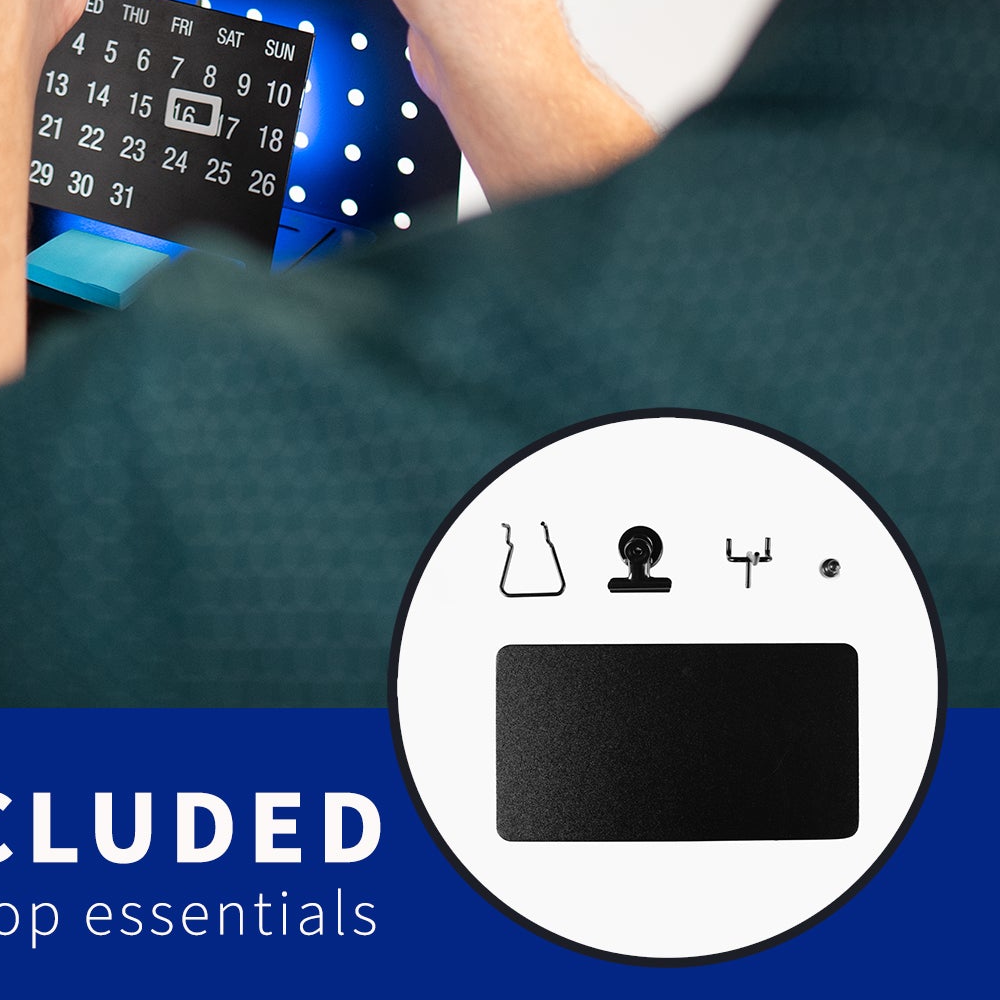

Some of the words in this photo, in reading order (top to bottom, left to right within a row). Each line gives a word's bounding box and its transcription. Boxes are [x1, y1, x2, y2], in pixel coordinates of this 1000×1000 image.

[72, 32, 86, 55] 4
[104, 40, 118, 63] 5
[137, 48, 151, 71] 6
[170, 56, 184, 79] 7
[203, 64, 217, 88] 8
[237, 73, 251, 97] 9
[266, 80, 292, 107] 10
[122, 4, 149, 25] THU
[170, 16, 193, 36] FRI
[217, 27, 244, 48] SAT
[265, 39, 296, 62] SUN
[46, 70, 69, 96] 13
[87, 81, 110, 107] 14
[129, 92, 153, 118] 15
[174, 103, 196, 124] 16
[216, 114, 240, 140] 17
[259, 125, 283, 152] 18
[29, 160, 54, 187] 29
[67, 170, 94, 197] 30
[110, 182, 134, 209] 31
[38, 114, 63, 140] 21
[78, 124, 105, 151] 22
[120, 135, 147, 162] 23
[162, 146, 188, 173] 24
[205, 158, 232, 185] 25
[248, 169, 276, 197] 26
